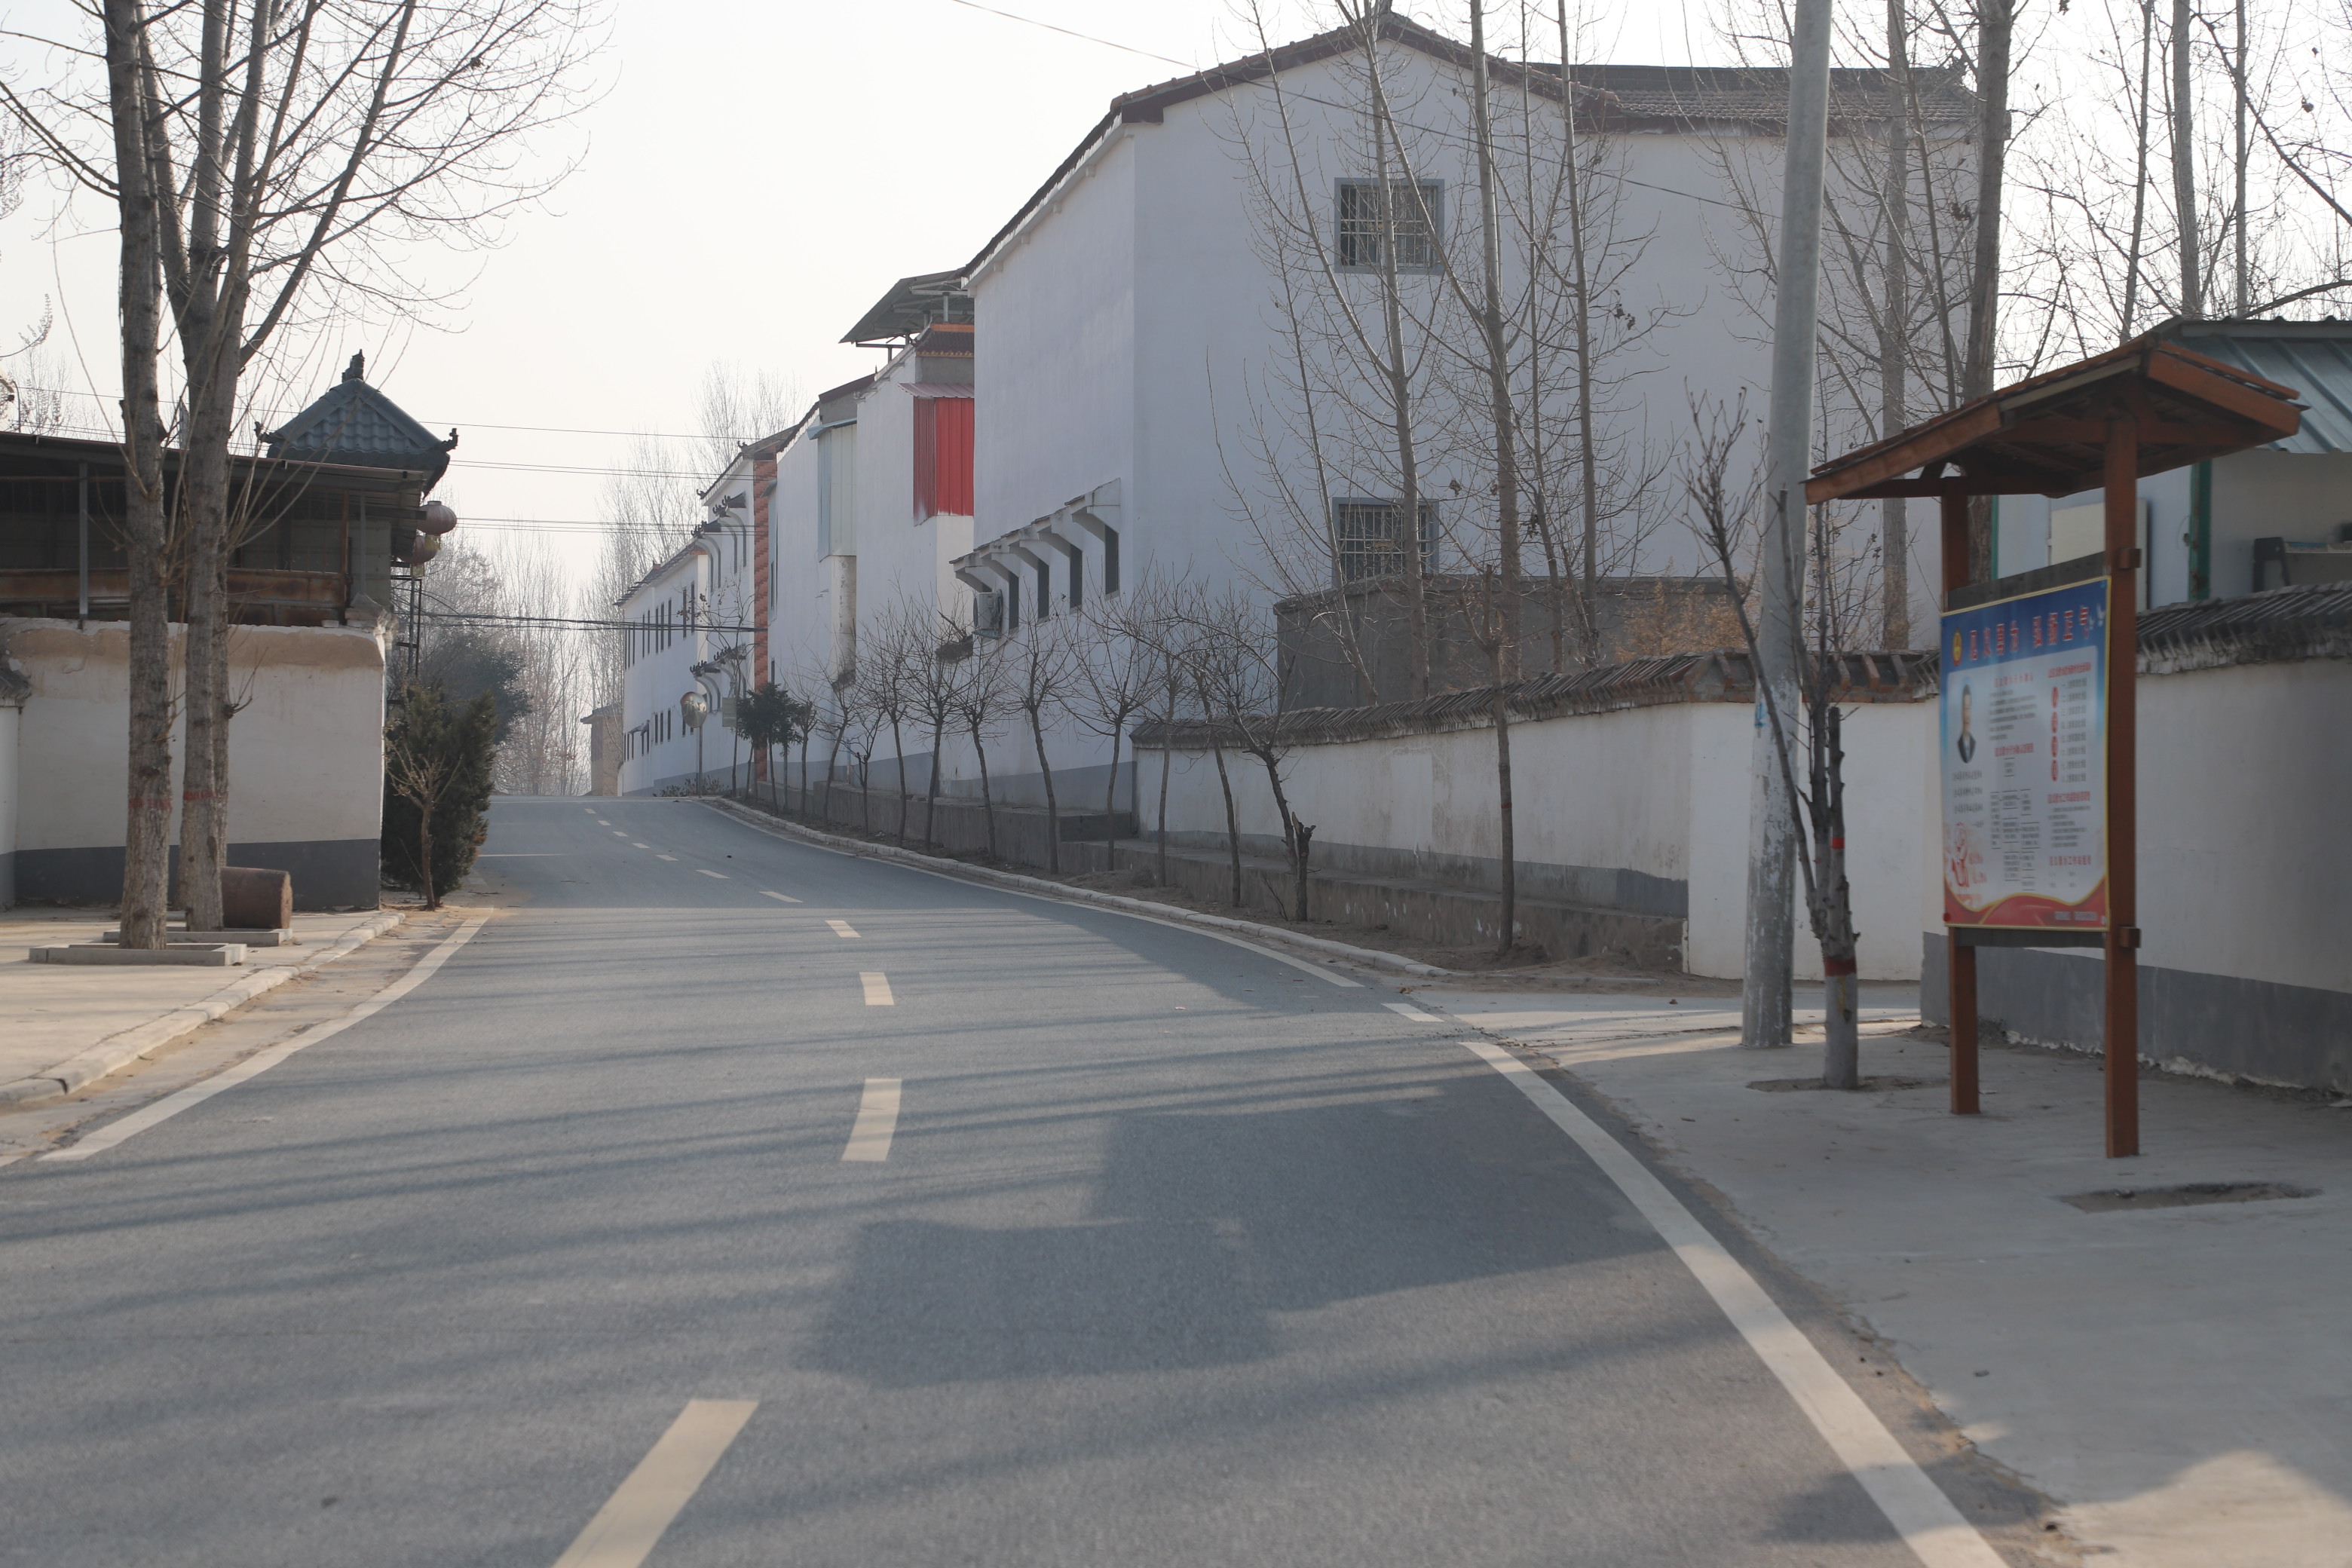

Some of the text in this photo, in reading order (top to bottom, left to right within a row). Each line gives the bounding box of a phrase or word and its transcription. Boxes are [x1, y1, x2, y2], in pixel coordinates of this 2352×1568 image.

[1970, 605, 2089, 660] 见义勇为 弘扬正气
